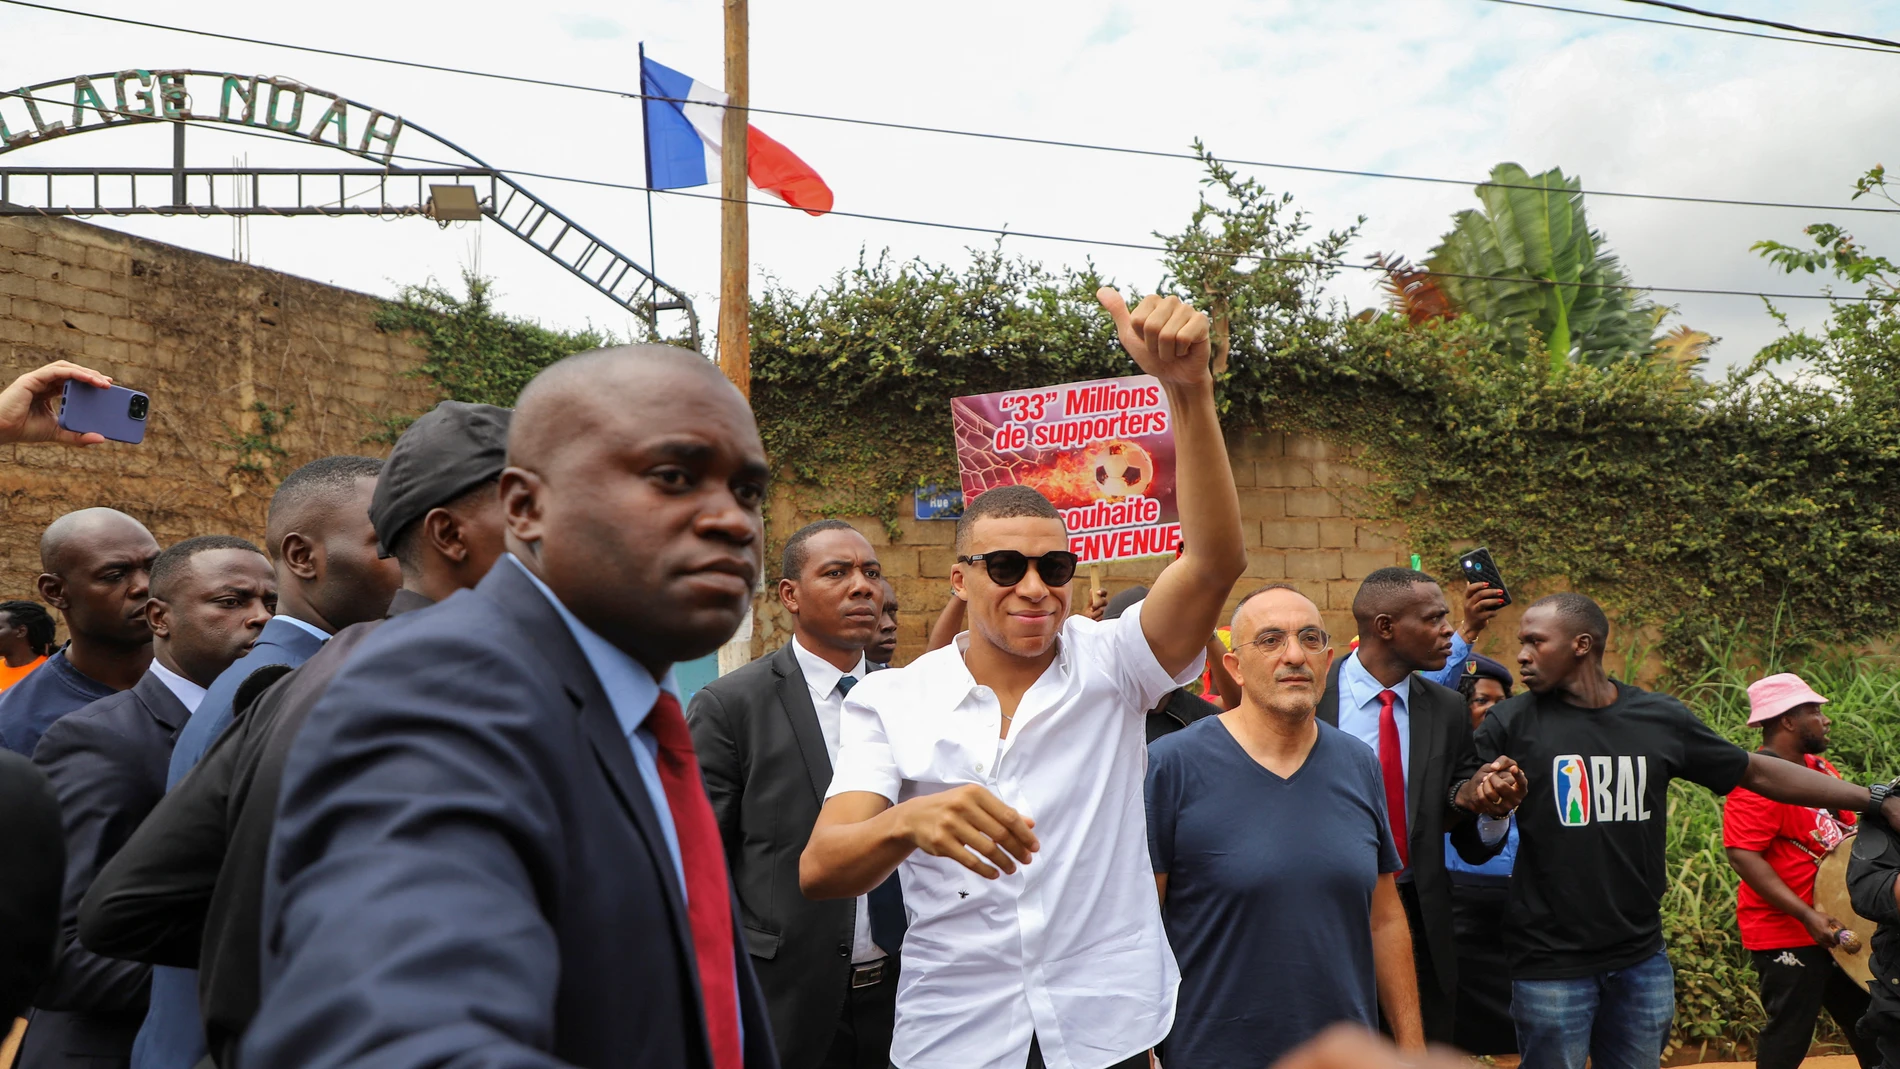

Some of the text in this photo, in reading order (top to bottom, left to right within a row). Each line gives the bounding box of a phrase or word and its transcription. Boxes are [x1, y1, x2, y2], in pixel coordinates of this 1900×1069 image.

[219, 72, 404, 163] NOAH
[1065, 384, 1159, 415] Millions
[996, 411, 1166, 450] de supporters
[929, 497, 949, 507] Rue
[1069, 525, 1180, 562] ENVENUE
[1590, 755, 1651, 822] BAL
